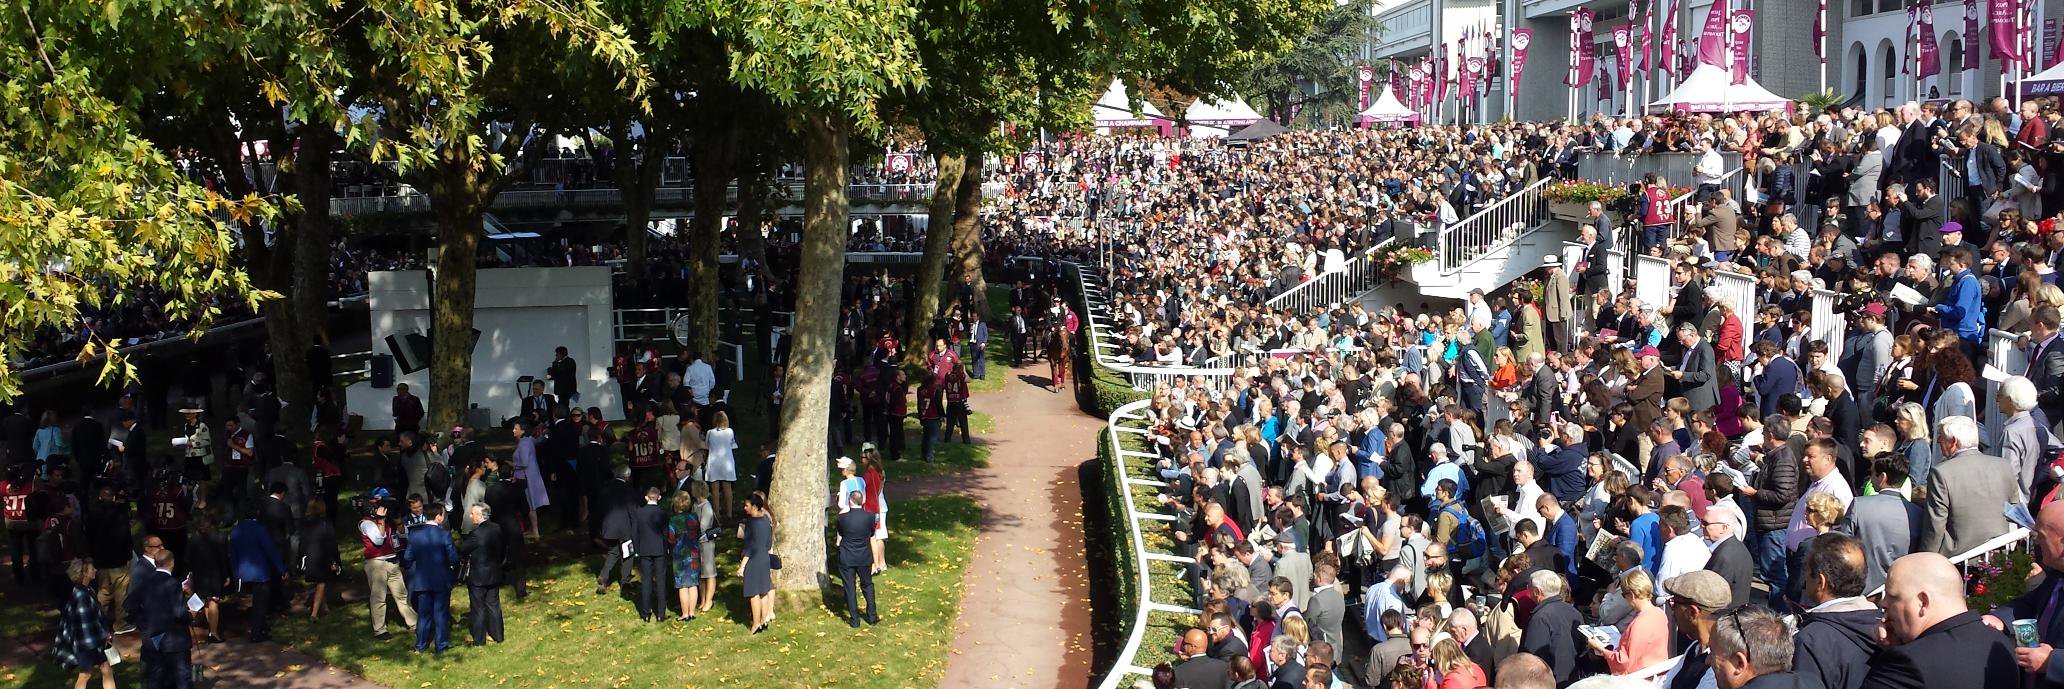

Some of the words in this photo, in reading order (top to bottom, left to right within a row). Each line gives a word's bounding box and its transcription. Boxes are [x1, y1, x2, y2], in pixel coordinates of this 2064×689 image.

[2031, 83, 2045, 93] BAR
[1656, 200, 1672, 215] 23
[1659, 213, 1670, 221] TV
